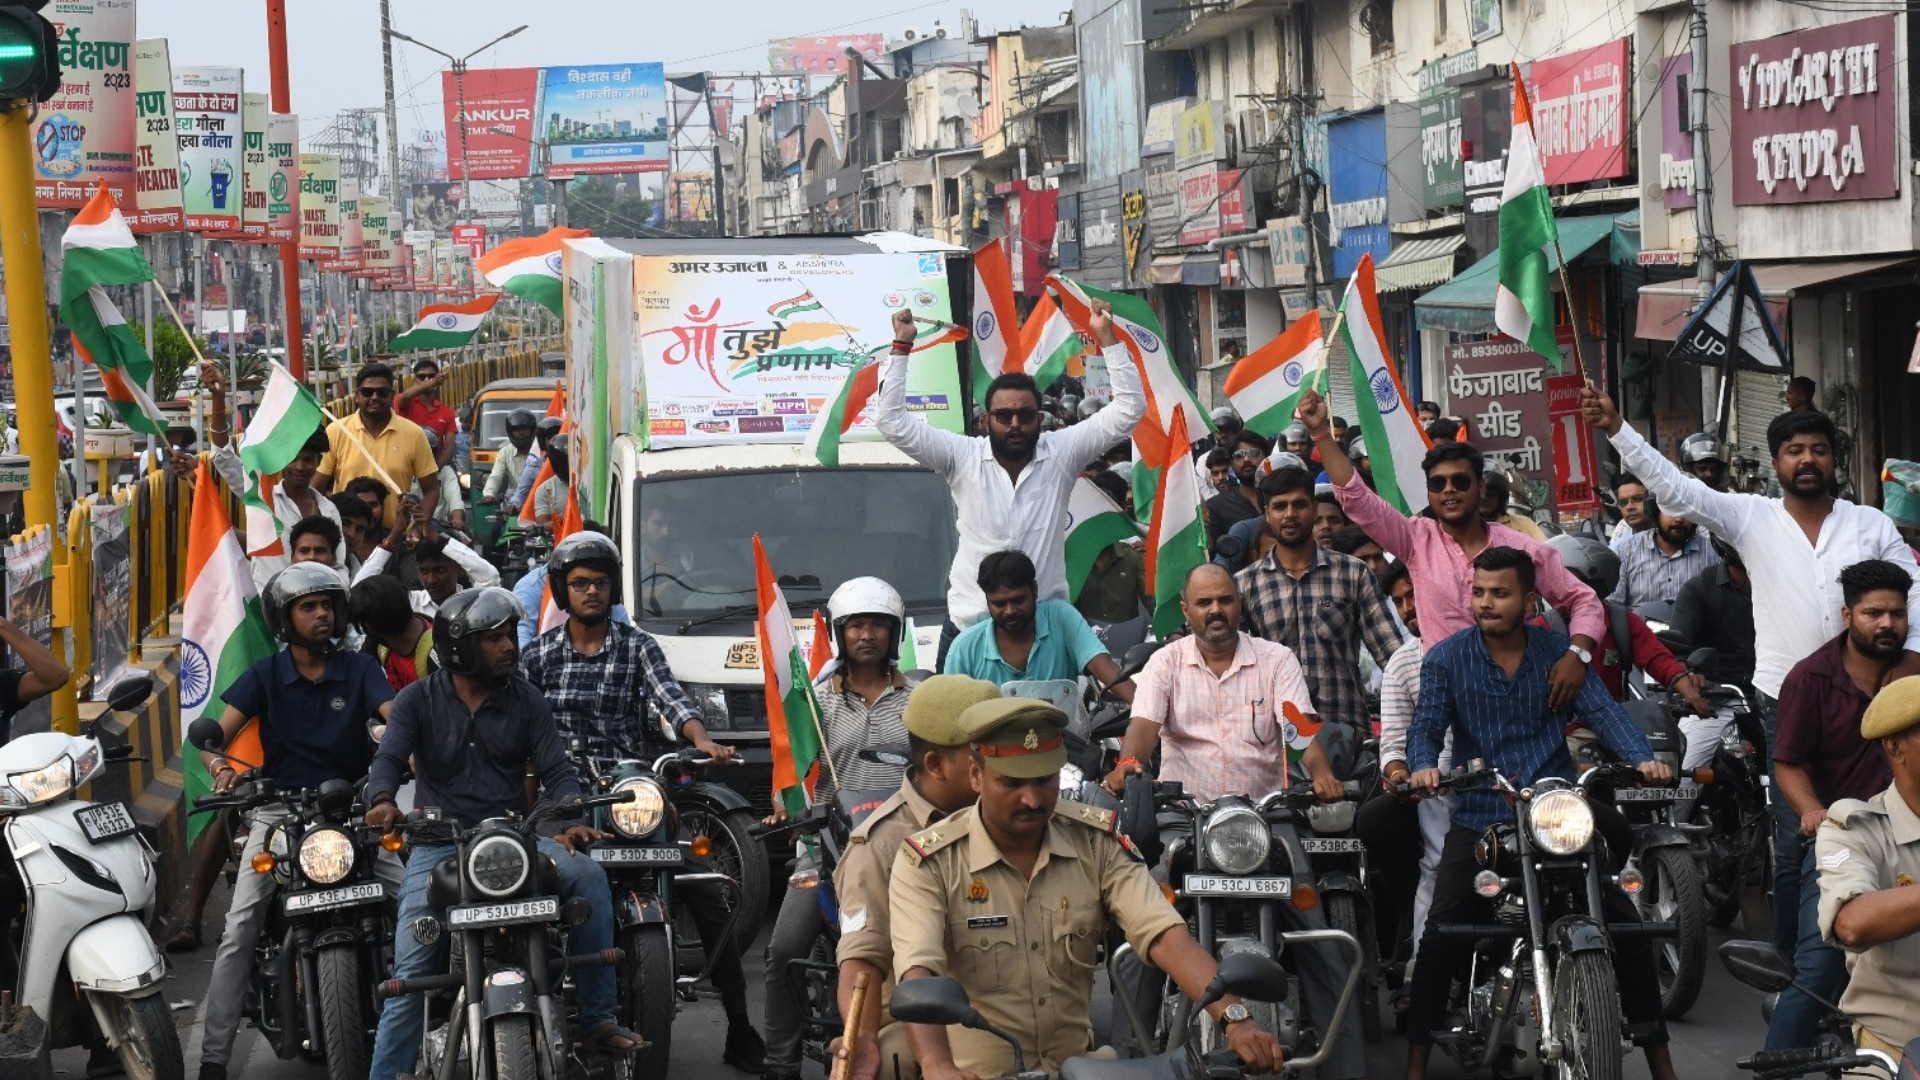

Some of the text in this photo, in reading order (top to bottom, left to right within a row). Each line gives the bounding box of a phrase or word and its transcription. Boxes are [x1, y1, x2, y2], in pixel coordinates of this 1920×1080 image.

[58, 27, 130, 71] र्वेक्षण
[104, 73, 130, 91] 2023
[1738, 42, 1879, 113] VIDYARTHI
[60, 125, 86, 141] STOP
[1752, 124, 1865, 195] KENDRA
[244, 191, 267, 209] EALTH
[304, 209, 326, 222] WASTE
[314, 223, 339, 237] WEALTH
[668, 261, 711, 274] अमर
[713, 260, 768, 273] उजाला
[778, 261, 788, 271] &
[641, 297, 787, 393] माँ तुझे
[1693, 329, 1726, 356] UP
[756, 352, 838, 373] प्रणाम
[1449, 363, 1545, 400] फैजाबाद
[1476, 401, 1523, 438] सीड
[1561, 414, 1586, 483] 1
[1561, 485, 1589, 499] FREE
[601, 849, 616, 860] UP
[652, 848, 680, 860] 9006
[300, 894, 314, 906] UP
[352, 884, 381, 898] 5001
[1201, 879, 1216, 890] UP
[1221, 879, 1251, 891] 53CJ
[465, 908, 481, 921] UP
[487, 902, 519, 919] 53AU
